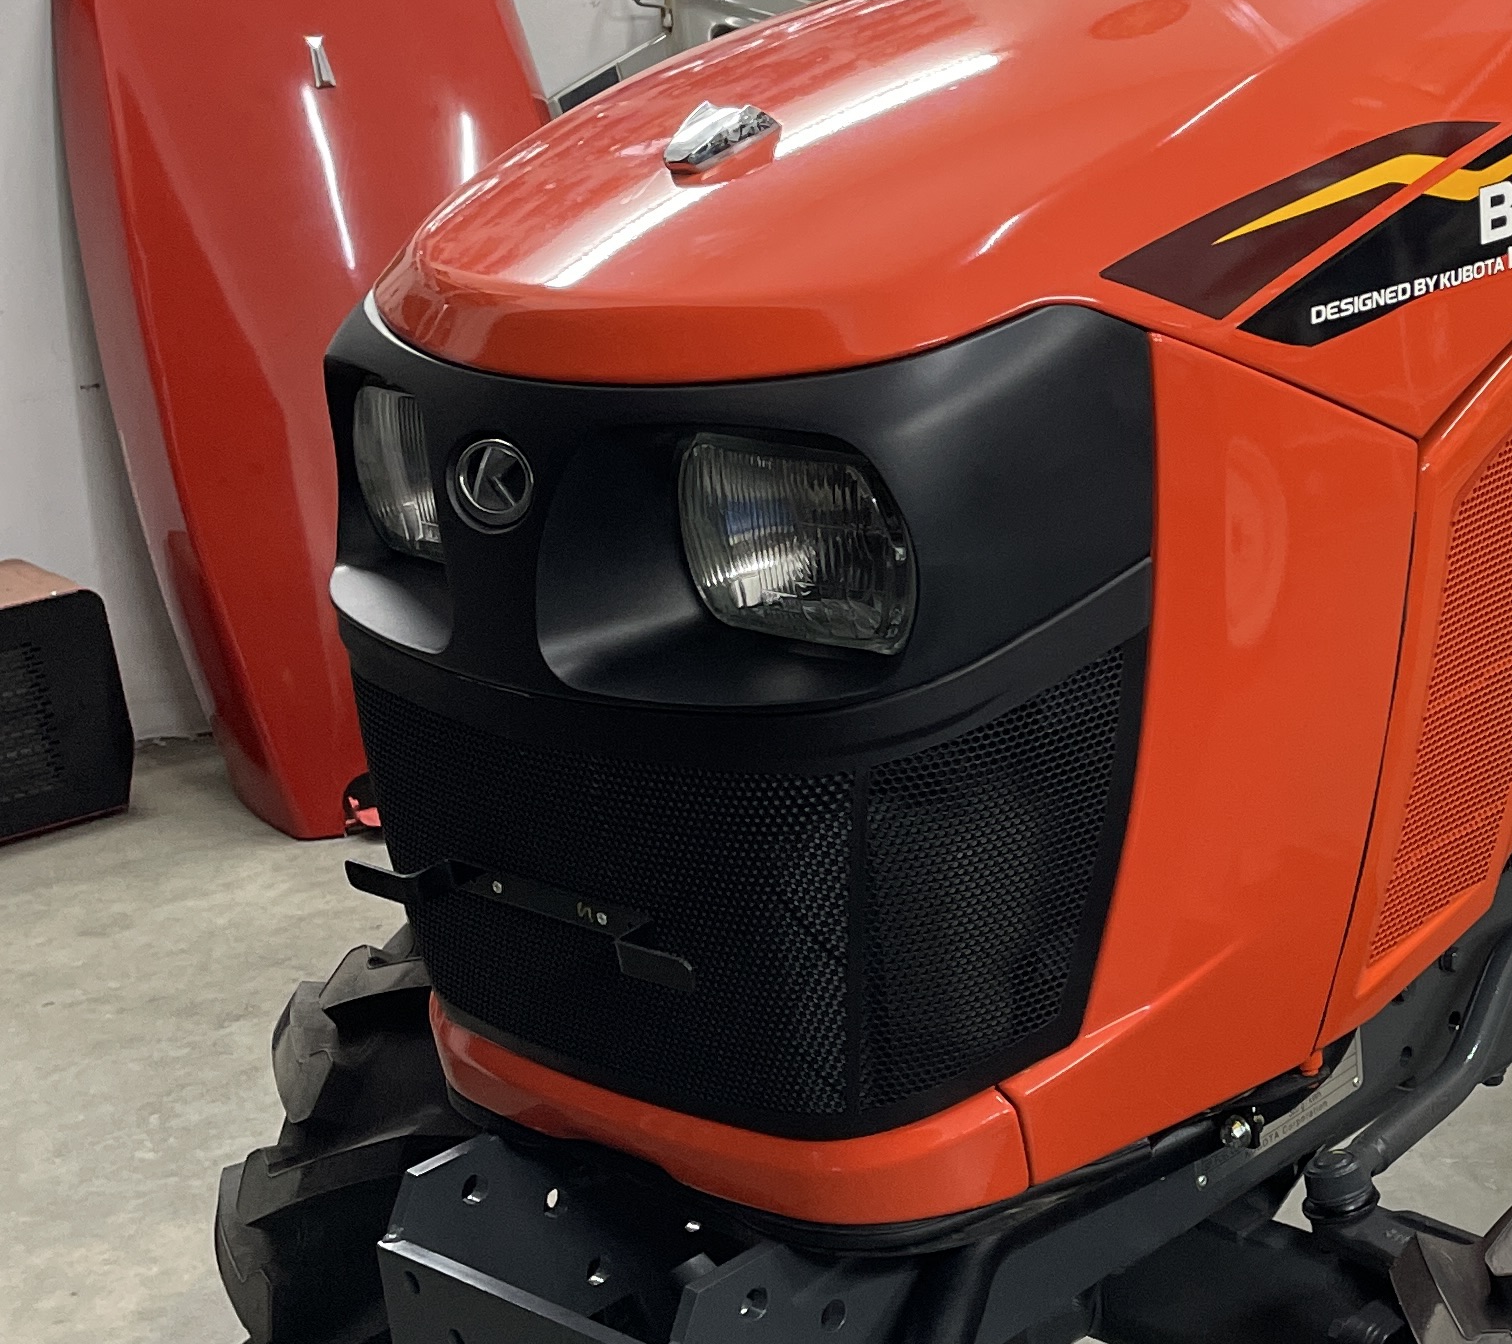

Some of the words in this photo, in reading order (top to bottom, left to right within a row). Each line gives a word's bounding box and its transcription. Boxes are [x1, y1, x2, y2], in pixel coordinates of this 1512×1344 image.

[1310, 282, 1411, 325] DESIGNED
[1414, 273, 1439, 298] BY
[1439, 256, 1505, 291] KUBOTA
